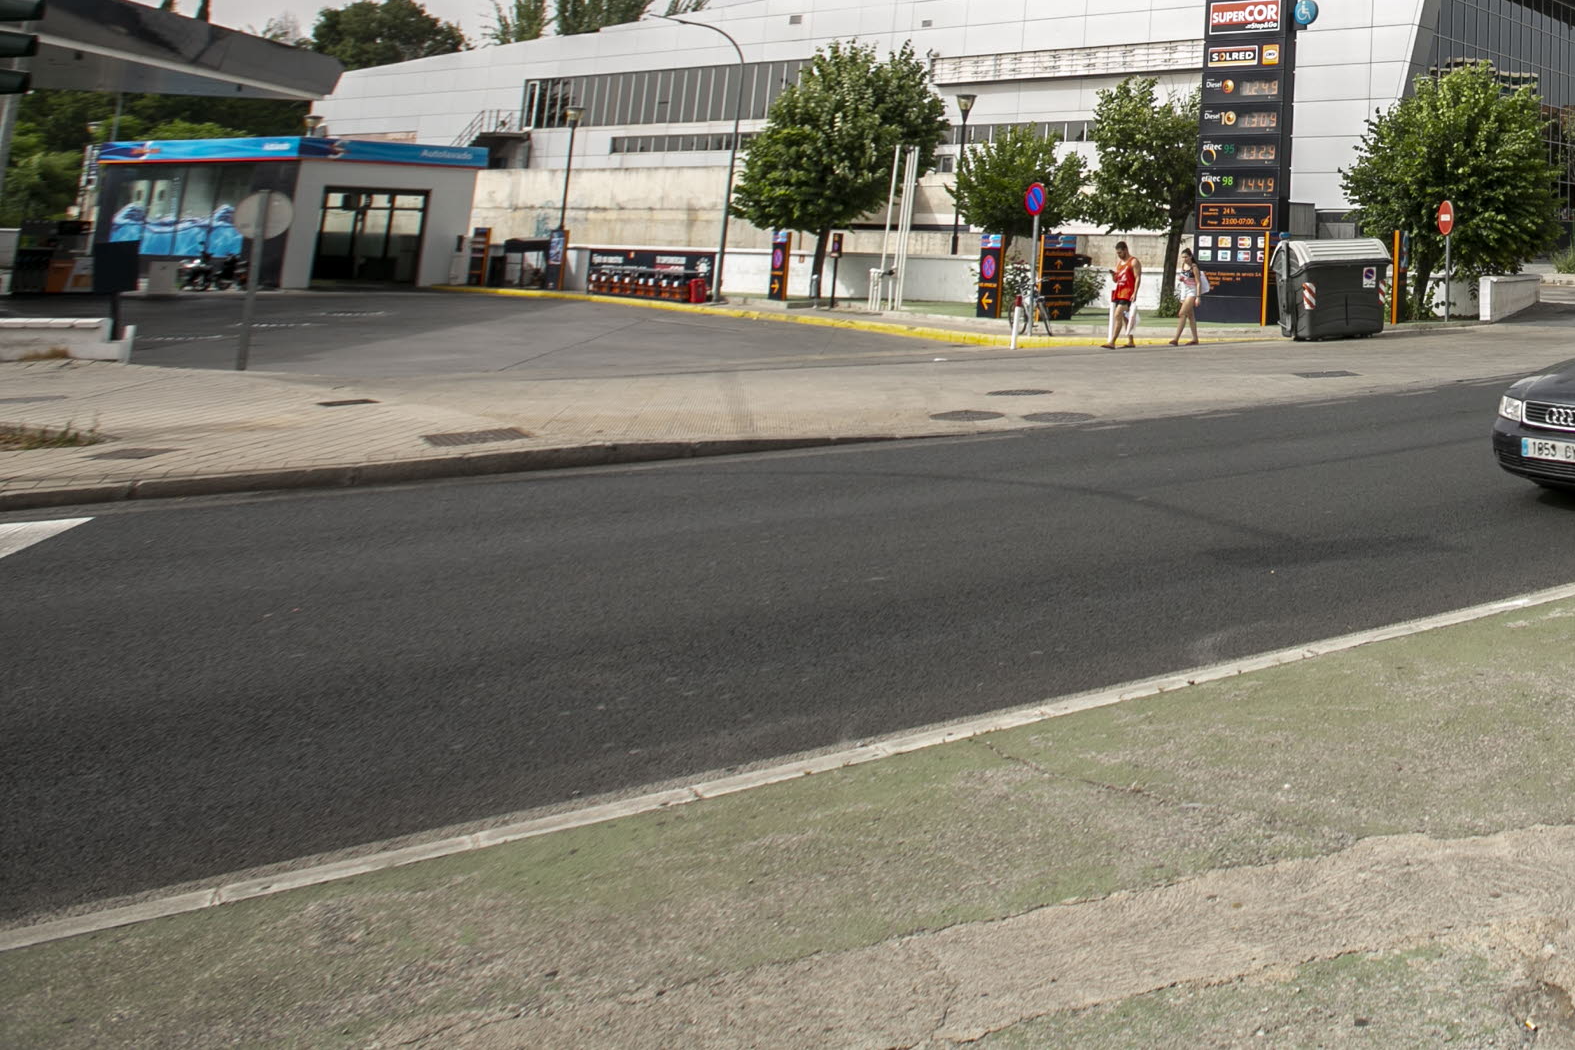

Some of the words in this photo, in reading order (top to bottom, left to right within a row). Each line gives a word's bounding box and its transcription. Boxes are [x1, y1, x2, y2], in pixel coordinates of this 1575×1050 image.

[1212, 4, 1278, 24] SUPERCOR
[1212, 51, 1254, 62] SOLRED
[1206, 80, 1223, 88] Diesel
[1204, 112, 1221, 120] Diesel
[1224, 143, 1235, 154] 95
[1222, 176, 1234, 186] 98
